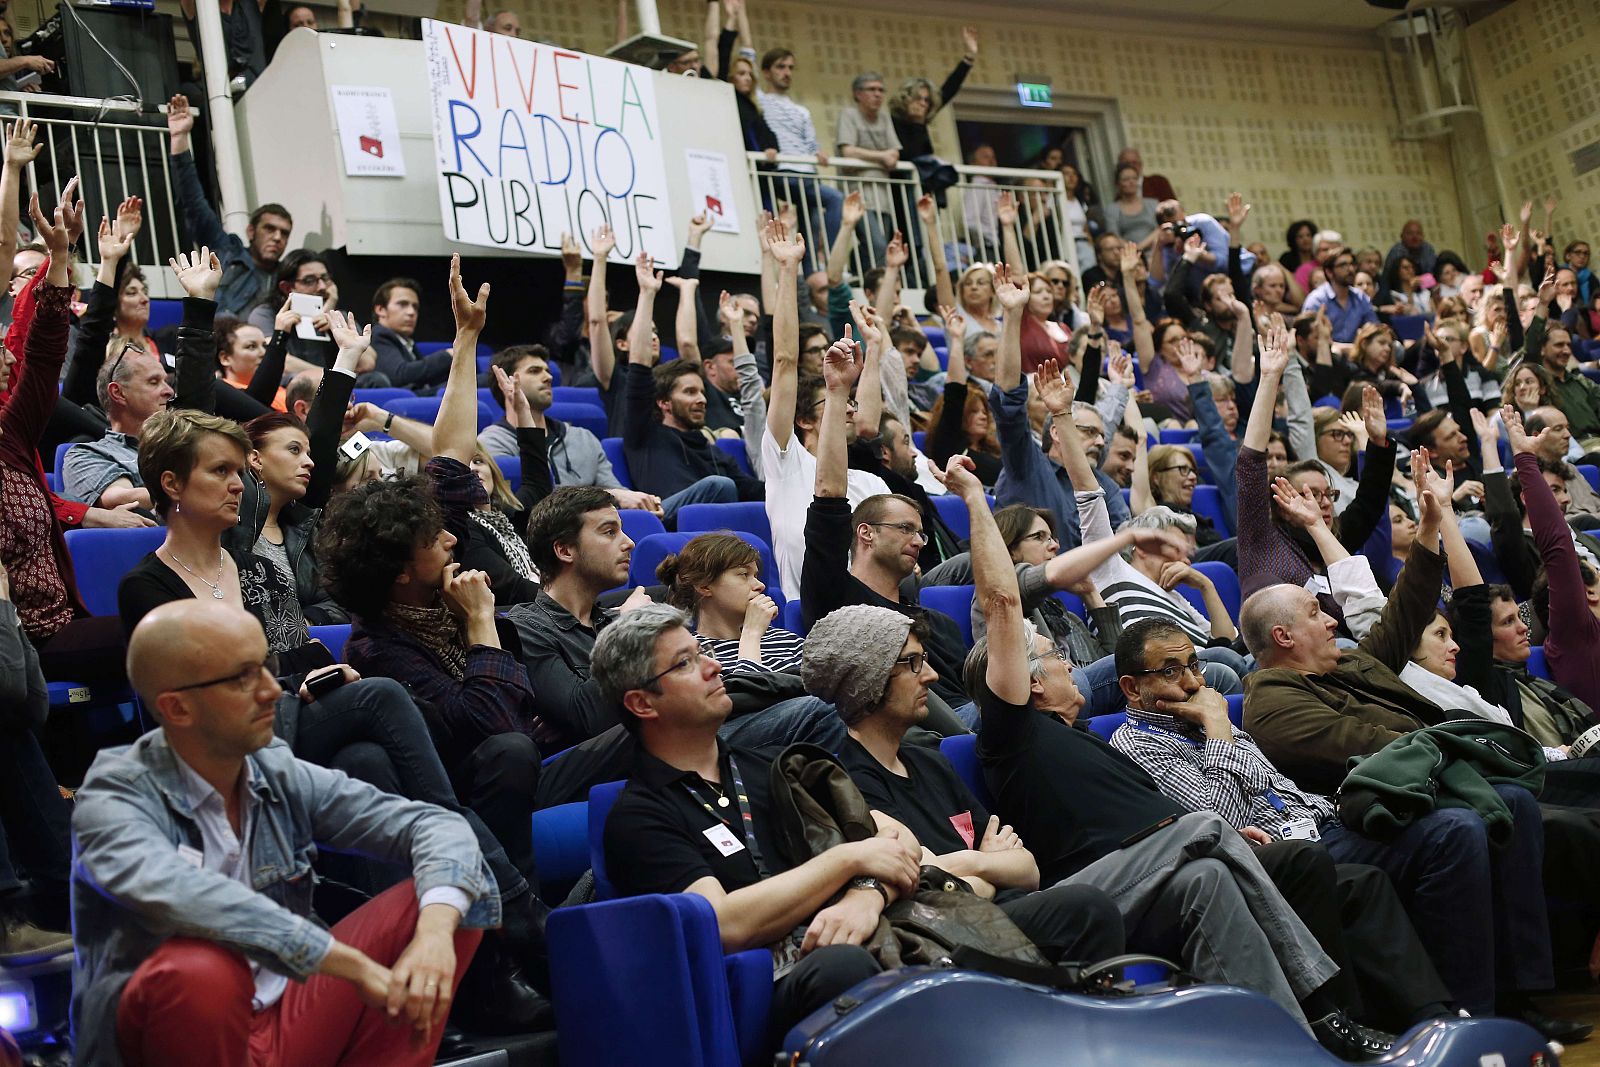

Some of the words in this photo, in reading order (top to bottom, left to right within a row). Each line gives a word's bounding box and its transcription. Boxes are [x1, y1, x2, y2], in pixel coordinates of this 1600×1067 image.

[587, 59, 655, 140] LA
[449, 99, 636, 199] RADIO
[442, 171, 666, 265] PUBLIQUE
[1148, 724, 1169, 735] france
[1170, 732, 1187, 741] radio
[1567, 734, 1592, 759] OUPE
